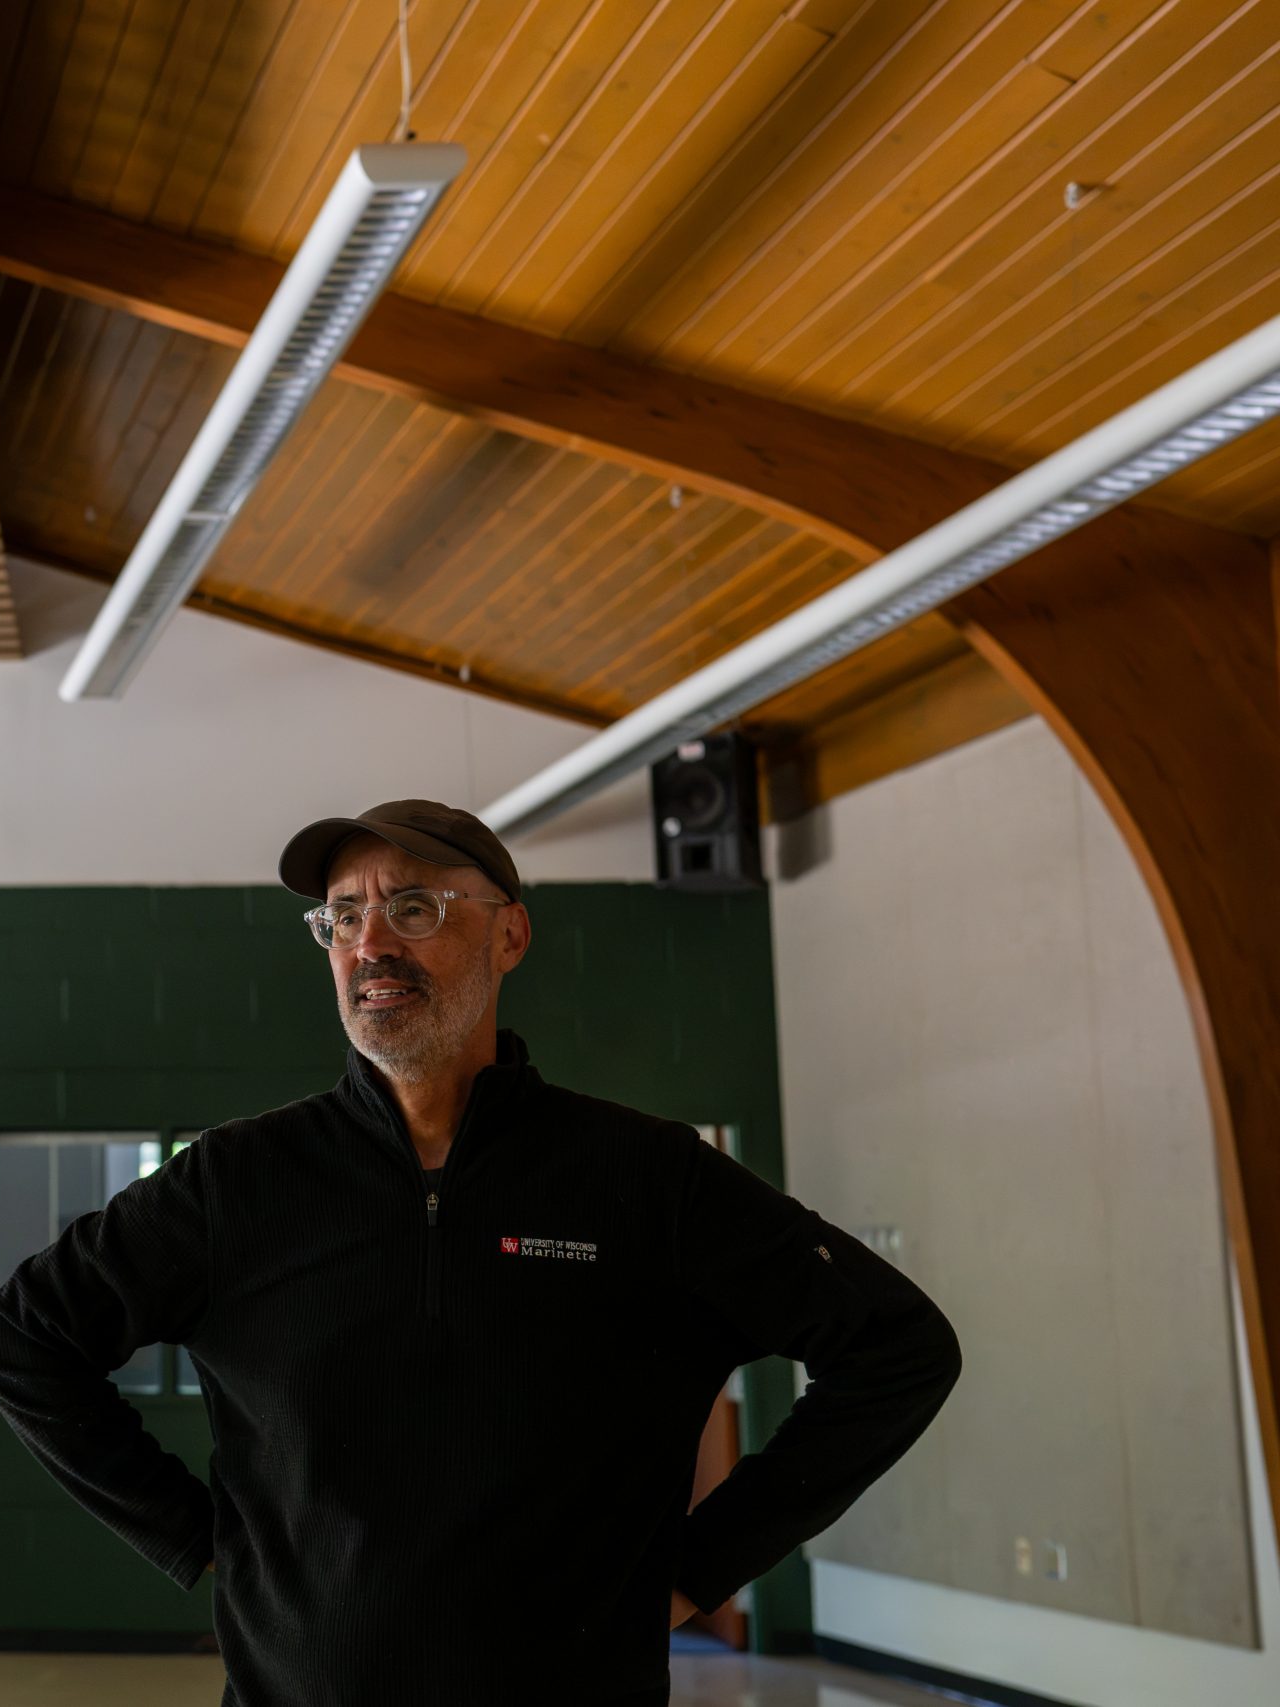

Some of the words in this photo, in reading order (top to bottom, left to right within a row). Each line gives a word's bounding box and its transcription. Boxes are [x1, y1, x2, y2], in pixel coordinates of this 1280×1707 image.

[520, 1238, 554, 1248] UNIVERSITY
[556, 1240, 564, 1249] OF
[565, 1241, 597, 1252] WISCONSIN
[521, 1246, 596, 1261] Marinette
